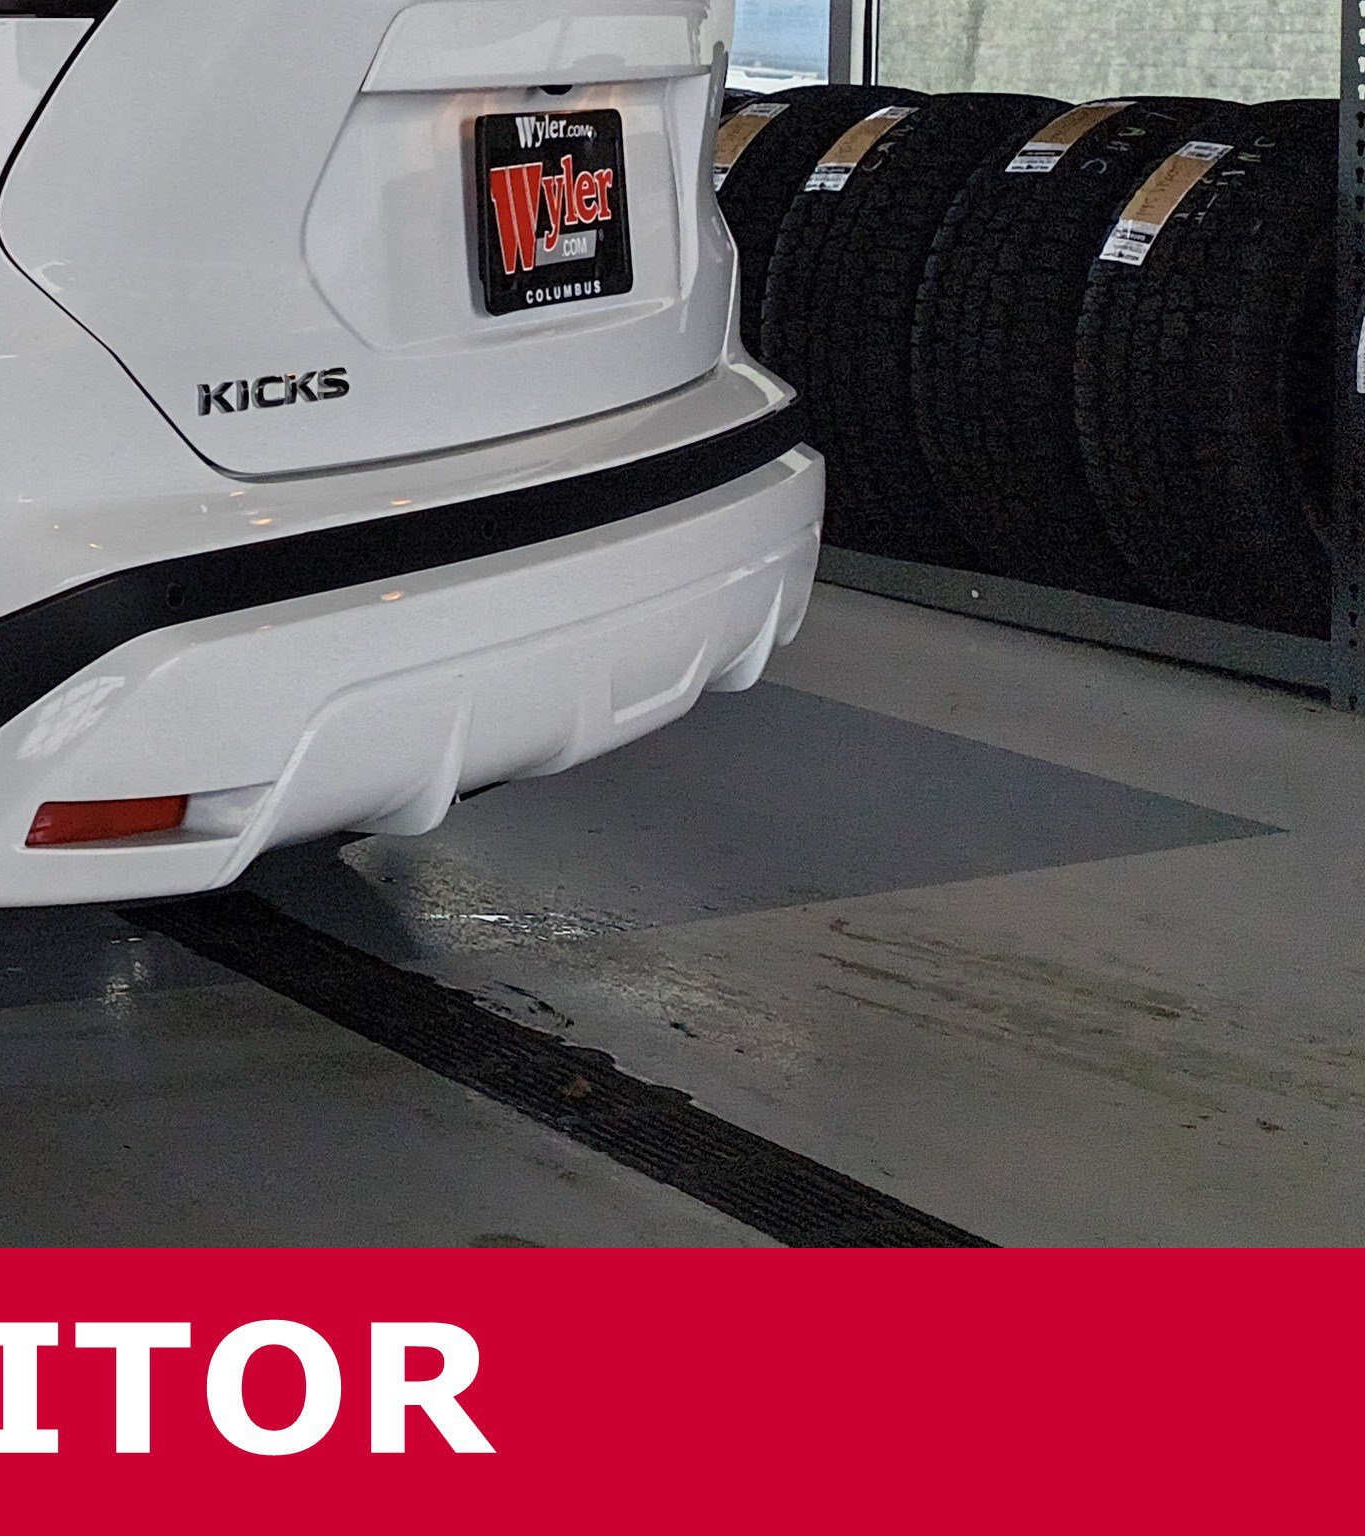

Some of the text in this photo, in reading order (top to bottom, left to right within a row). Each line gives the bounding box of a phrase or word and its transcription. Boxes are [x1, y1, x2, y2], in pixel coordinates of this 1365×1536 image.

[489, 154, 613, 275] Wyler
[525, 280, 602, 304] COLUMBUS
[196, 366, 350, 416] KICKS
